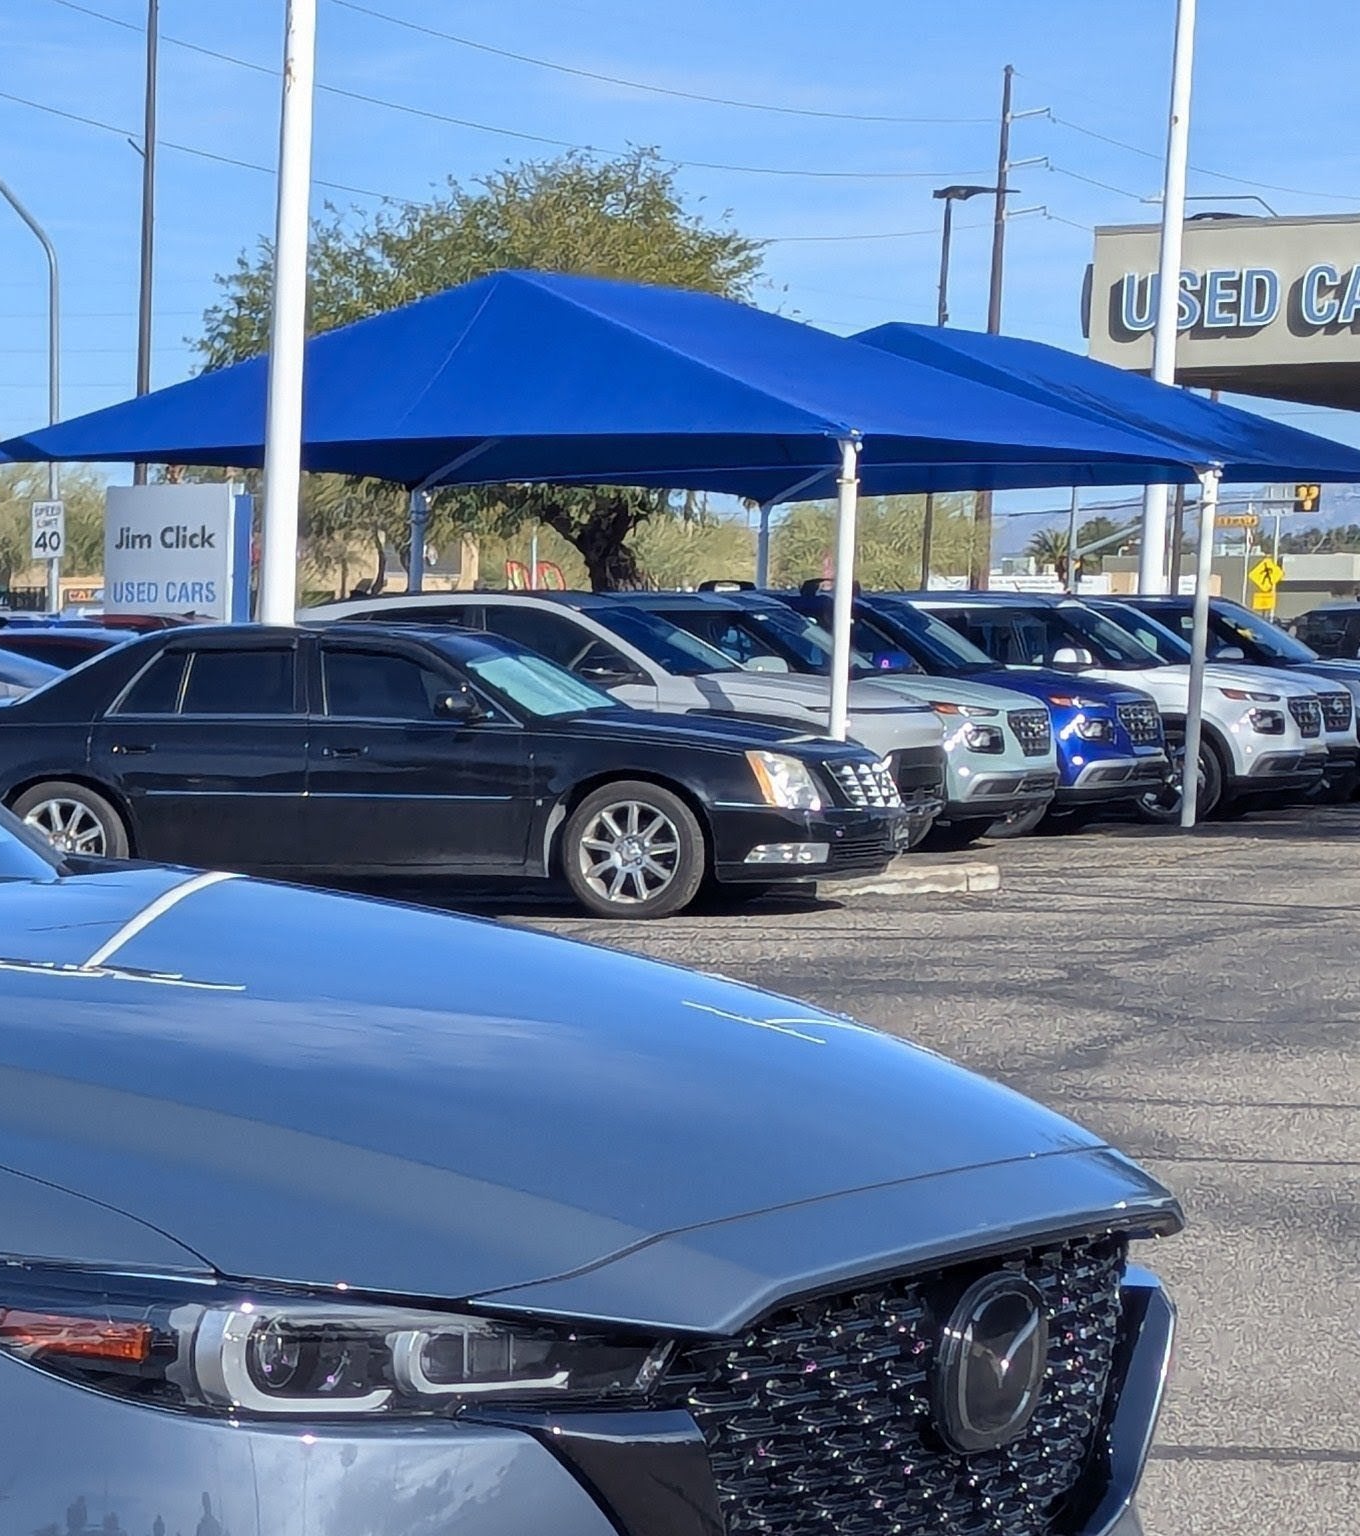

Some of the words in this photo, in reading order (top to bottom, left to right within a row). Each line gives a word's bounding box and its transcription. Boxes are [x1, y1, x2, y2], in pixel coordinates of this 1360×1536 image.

[1121, 267, 1280, 331] USED
[34, 505, 62, 517] SPEED
[34, 530, 62, 552] 40
[114, 526, 152, 550] Jim
[160, 524, 216, 549] Click
[112, 580, 158, 604] USED
[166, 580, 217, 603] CARS
